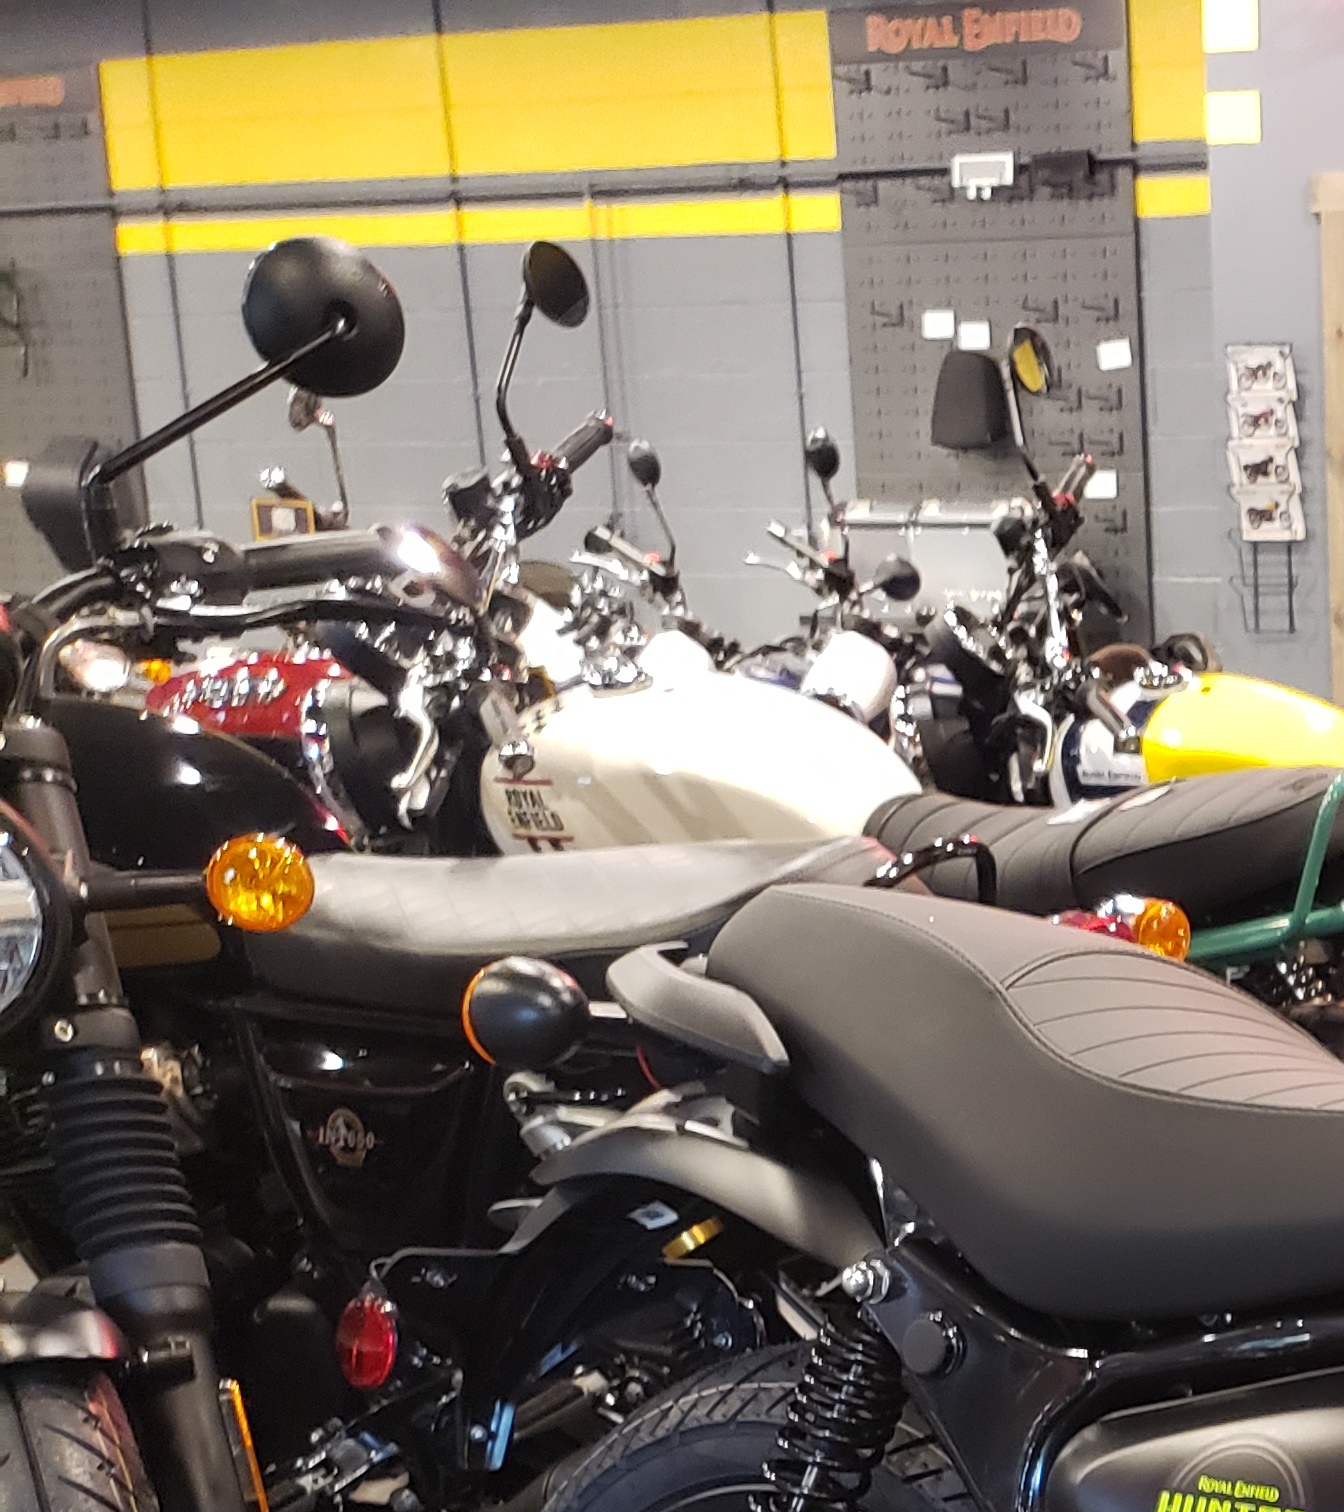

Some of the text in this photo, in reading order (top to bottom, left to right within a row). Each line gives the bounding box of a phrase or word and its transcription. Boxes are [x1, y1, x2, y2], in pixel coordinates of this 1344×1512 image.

[865, 7, 1082, 53] ROYAL ENFIELD
[1198, 1475, 1280, 1503] ROYAL ENFIELD
